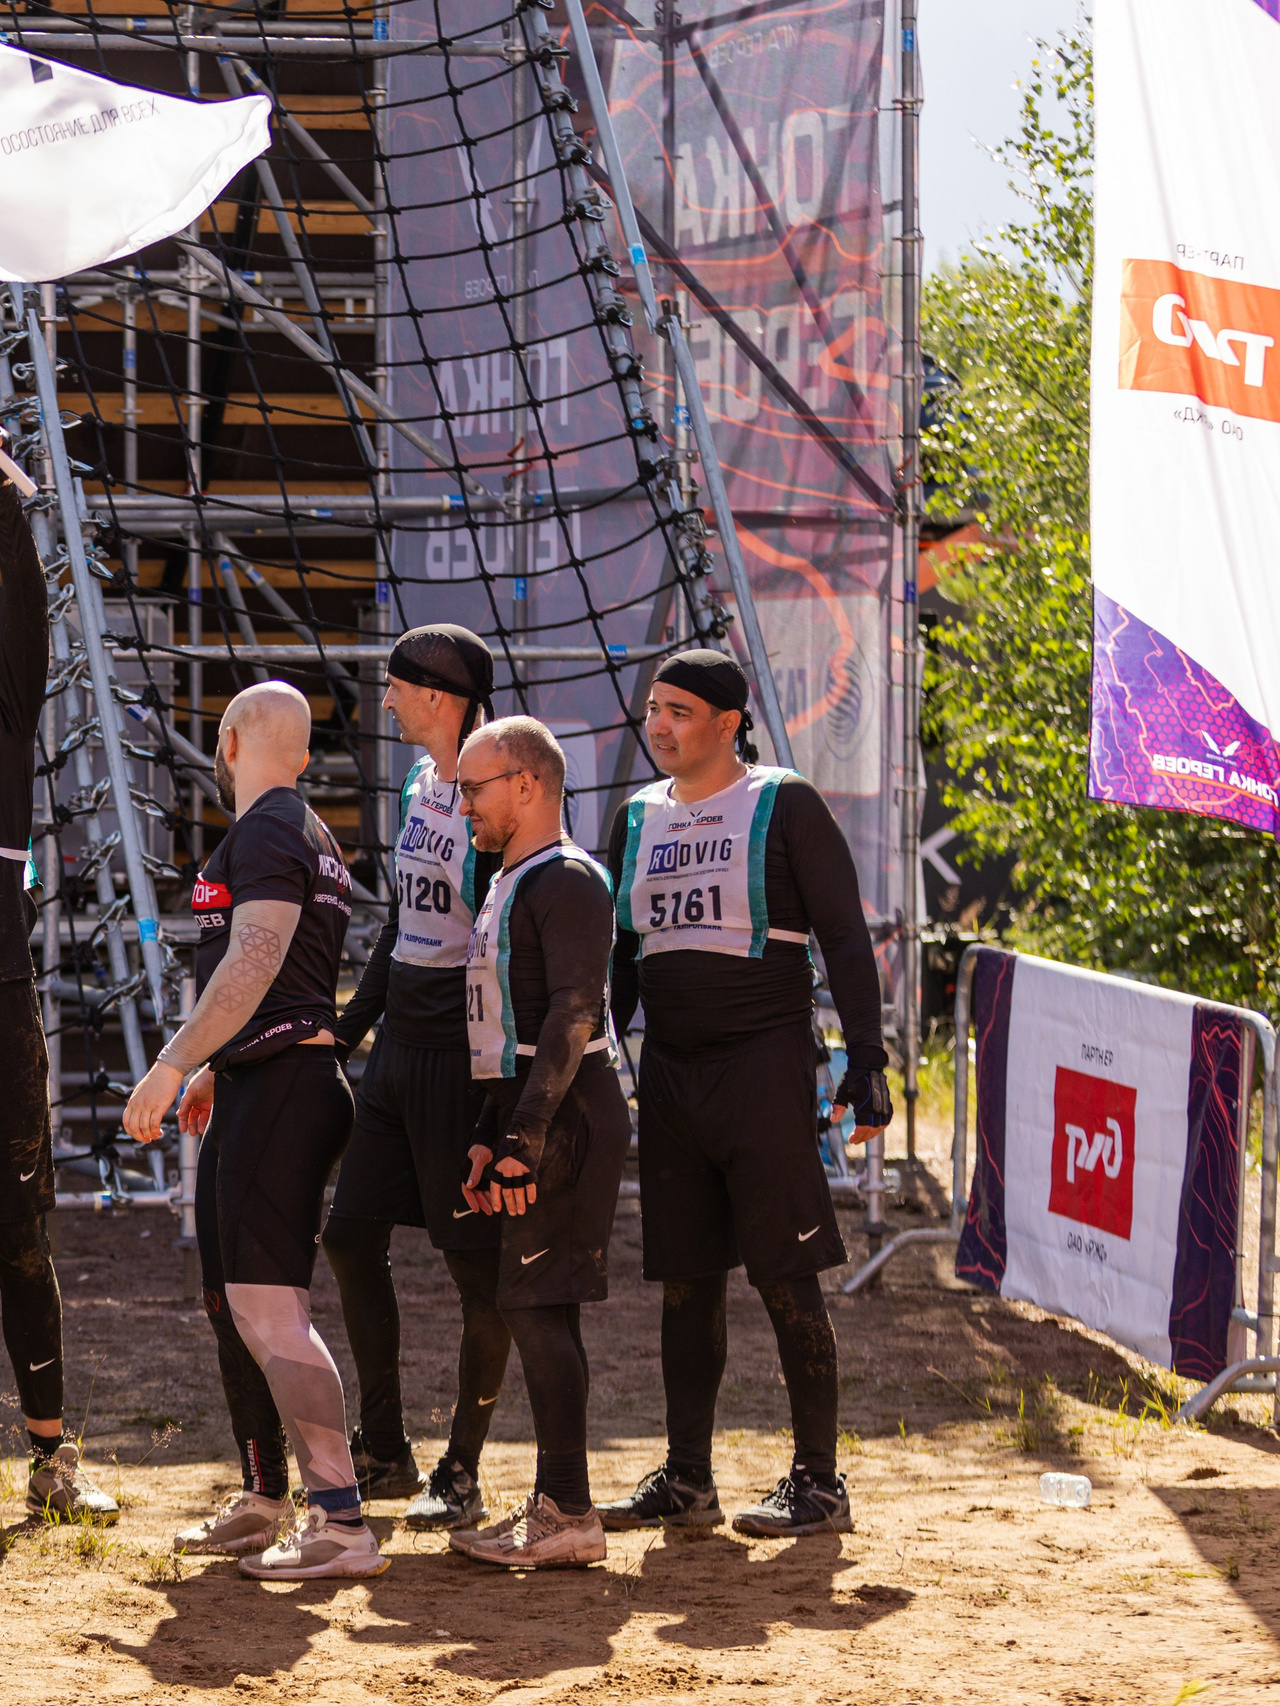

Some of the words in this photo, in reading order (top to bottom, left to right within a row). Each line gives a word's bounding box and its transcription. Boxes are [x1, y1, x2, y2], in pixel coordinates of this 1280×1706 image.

[89, 108, 122, 135] ДЛЯ
[120, 97, 161, 124] ВСЕХ
[402, 821, 455, 862] RODVIG
[649, 837, 733, 871] RODVIG
[649, 885, 723, 929] 5161
[403, 932, 443, 948] ГАЗПРОМБАНК
[1081, 1043, 1114, 1067] ПАРТНЕР
